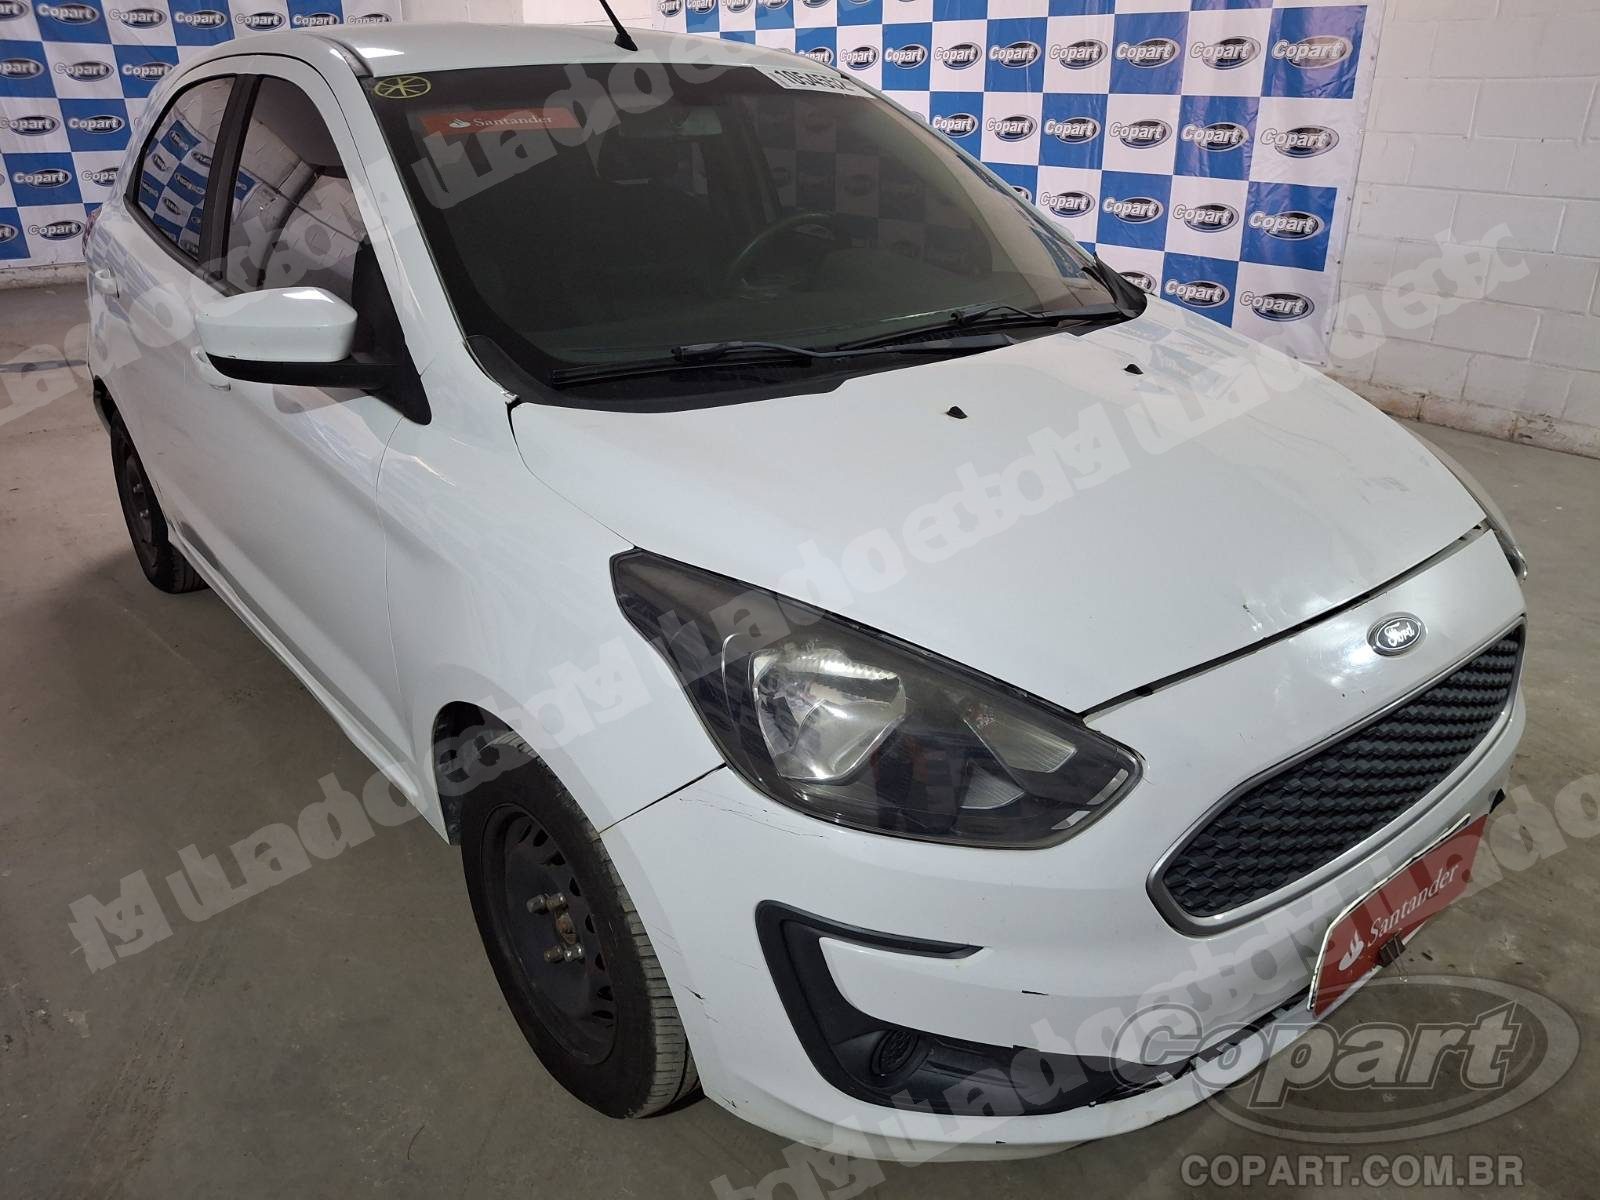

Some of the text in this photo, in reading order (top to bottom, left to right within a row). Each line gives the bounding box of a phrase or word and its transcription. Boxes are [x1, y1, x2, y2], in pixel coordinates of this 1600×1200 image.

[38, 3, 94, 20] Copart
[109, 9, 160, 23] Copart
[175, 12, 221, 23] Copart
[235, 13, 281, 26] Copart
[293, 14, 335, 27] Copart
[840, 49, 874, 65] Copart
[885, 47, 922, 63] Copart
[934, 46, 976, 65] Copart
[988, 44, 1034, 64] Copart
[1049, 43, 1100, 64] Copart
[1116, 41, 1172, 61] Copart
[1190, 41, 1249, 61] Copart
[1272, 39, 1343, 62] Copart
[54, 62, 106, 77] Copart
[122, 63, 169, 77] Copart
[68, 118, 118, 131] Copart
[473, 115, 552, 127] Santander
[932, 115, 973, 131] Copart
[986, 118, 1030, 135] Copart
[1044, 119, 1094, 138] Copart
[1109, 122, 1163, 141] Copart
[1181, 123, 1243, 145] Copart
[1260, 128, 1330, 149] Copart
[13, 172, 65, 185] Copart
[81, 170, 117, 183] Copa
[1040, 191, 1089, 211] Copart
[1102, 197, 1157, 218] Copart
[1173, 203, 1232, 225] Copart
[1249, 211, 1316, 235] Copart
[28, 223, 78, 236] Copart
[1164, 279, 1223, 302] Copart
[1239, 291, 1308, 316] Copart
[1383, 621, 1415, 647] Ford
[1367, 864, 1459, 947] Santander
